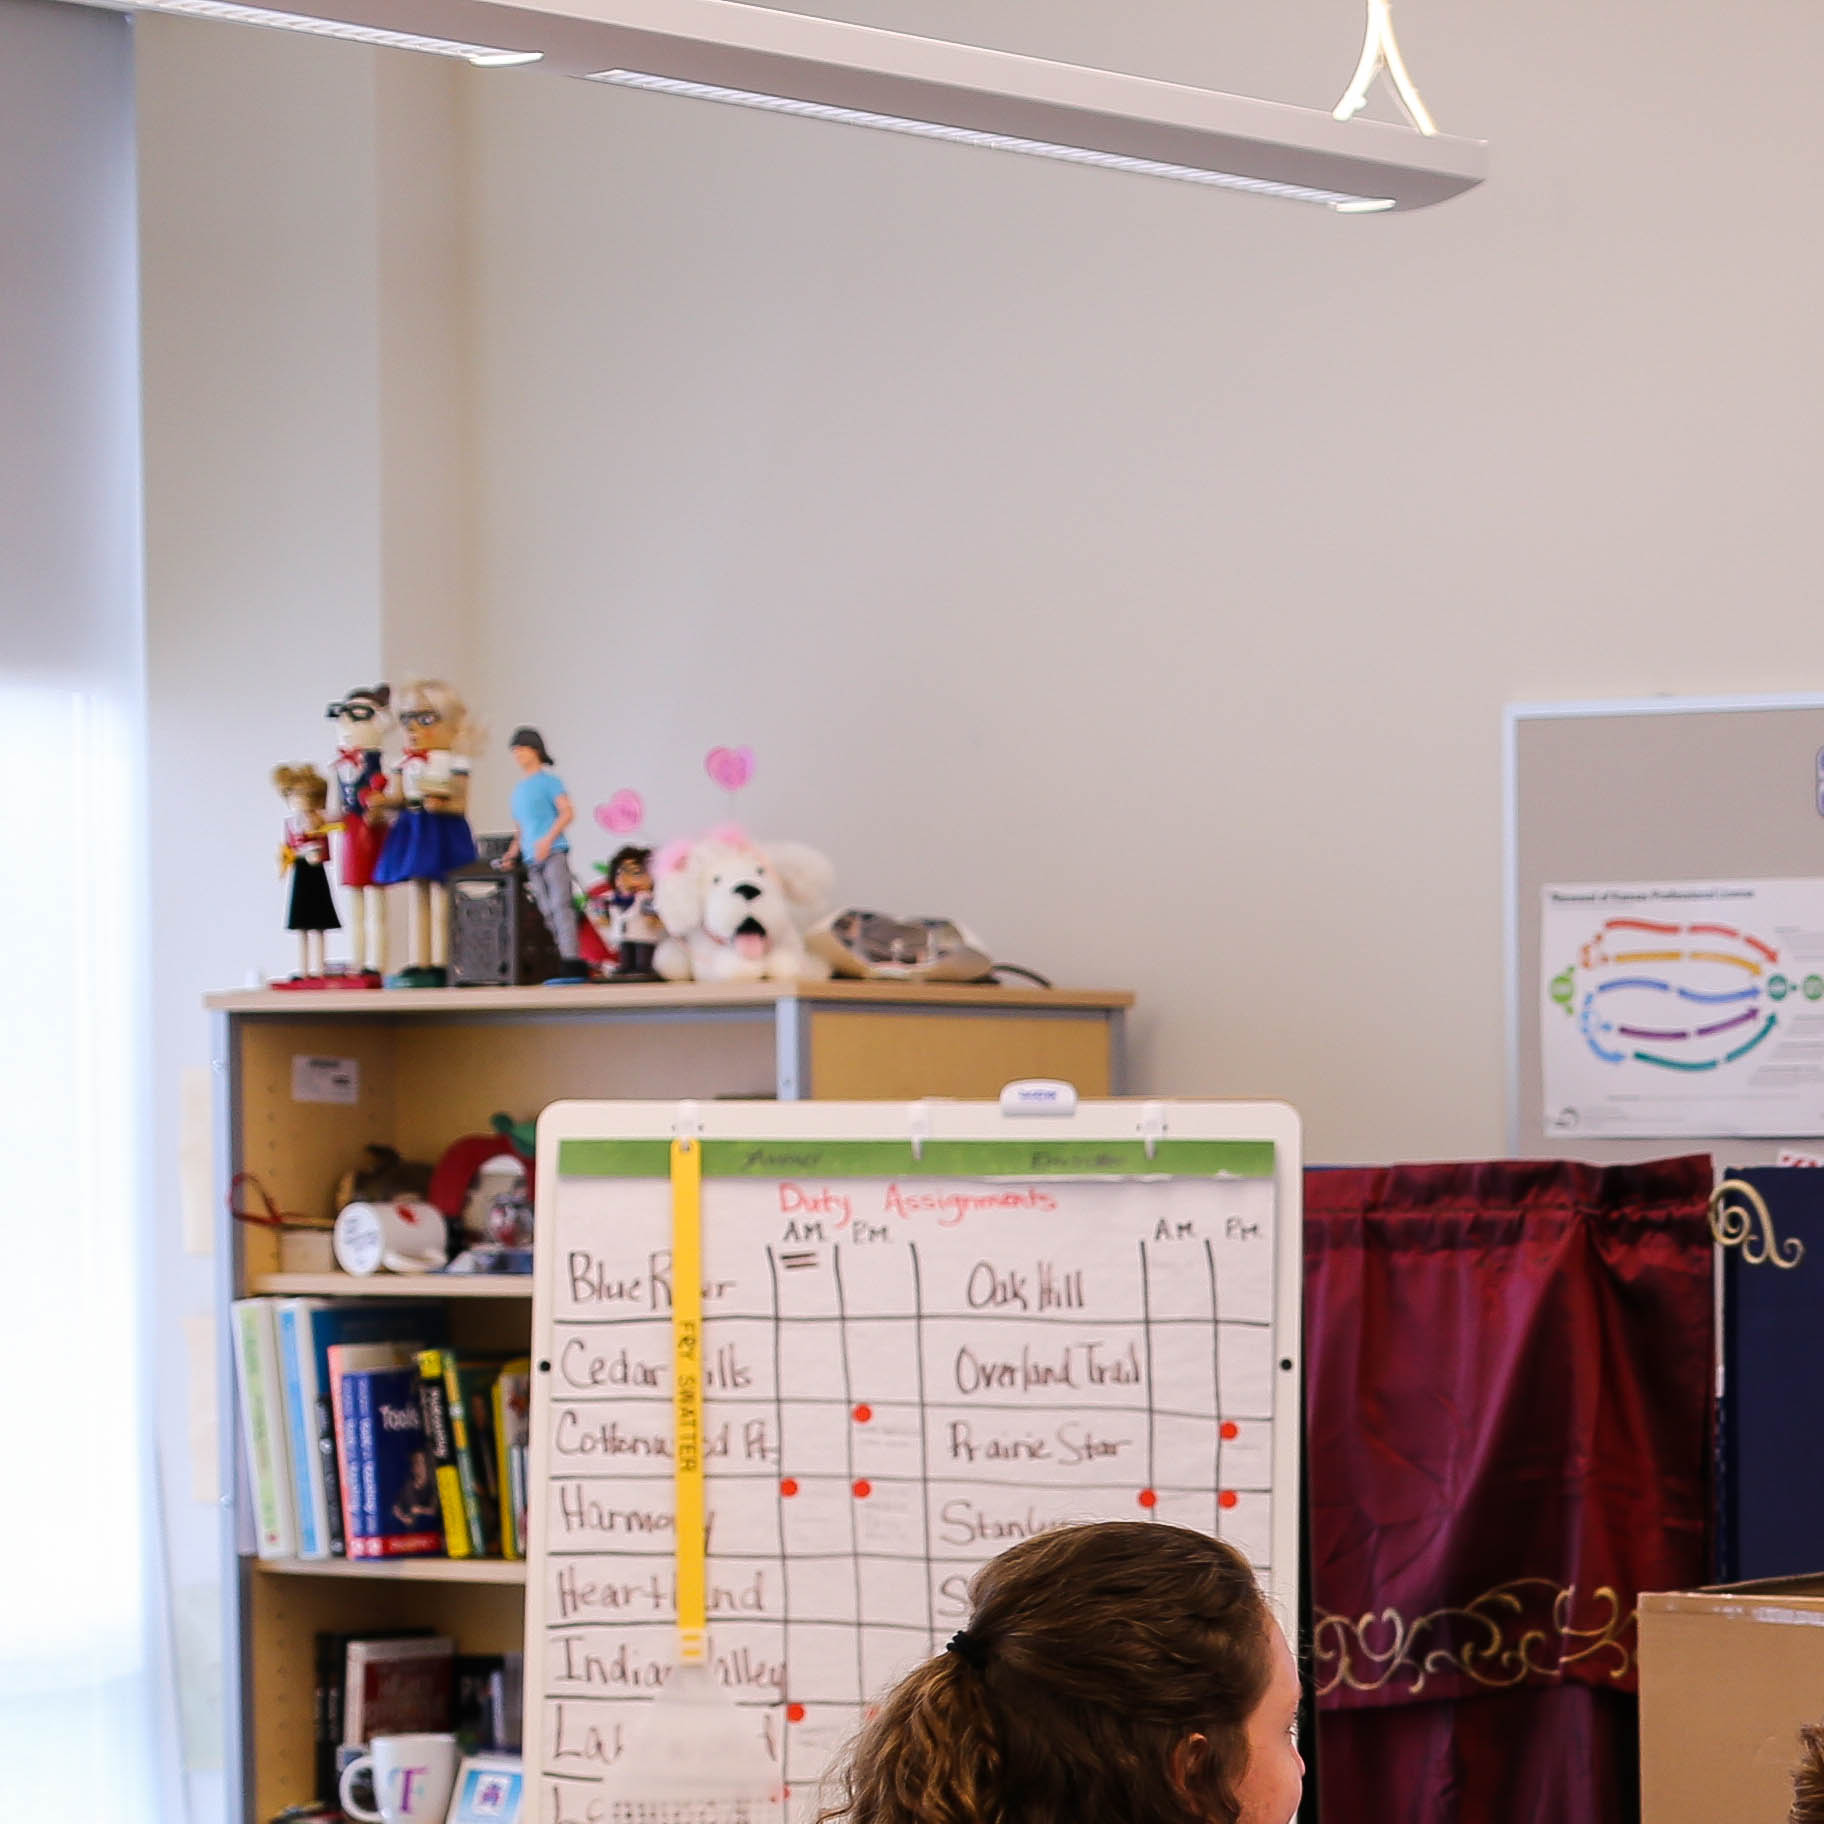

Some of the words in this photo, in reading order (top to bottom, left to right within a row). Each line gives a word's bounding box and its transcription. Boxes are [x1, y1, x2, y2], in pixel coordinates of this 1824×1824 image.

[779, 1183, 851, 1228] Duty
[884, 1183, 1057, 1226] Assignments
[570, 1253, 640, 1302] Blue
[967, 1259, 1028, 1310] Oak
[1037, 1257, 1086, 1312] Hill
[562, 1337, 668, 1390] Cedar
[956, 1345, 1079, 1395] Overland
[1077, 1341, 1141, 1385] Trail
[678, 1376, 699, 1473] SWATTER
[949, 1420, 1053, 1462] Prairie
[1058, 1421, 1133, 1466] Star
[561, 1483, 715, 1555] Harmoy
